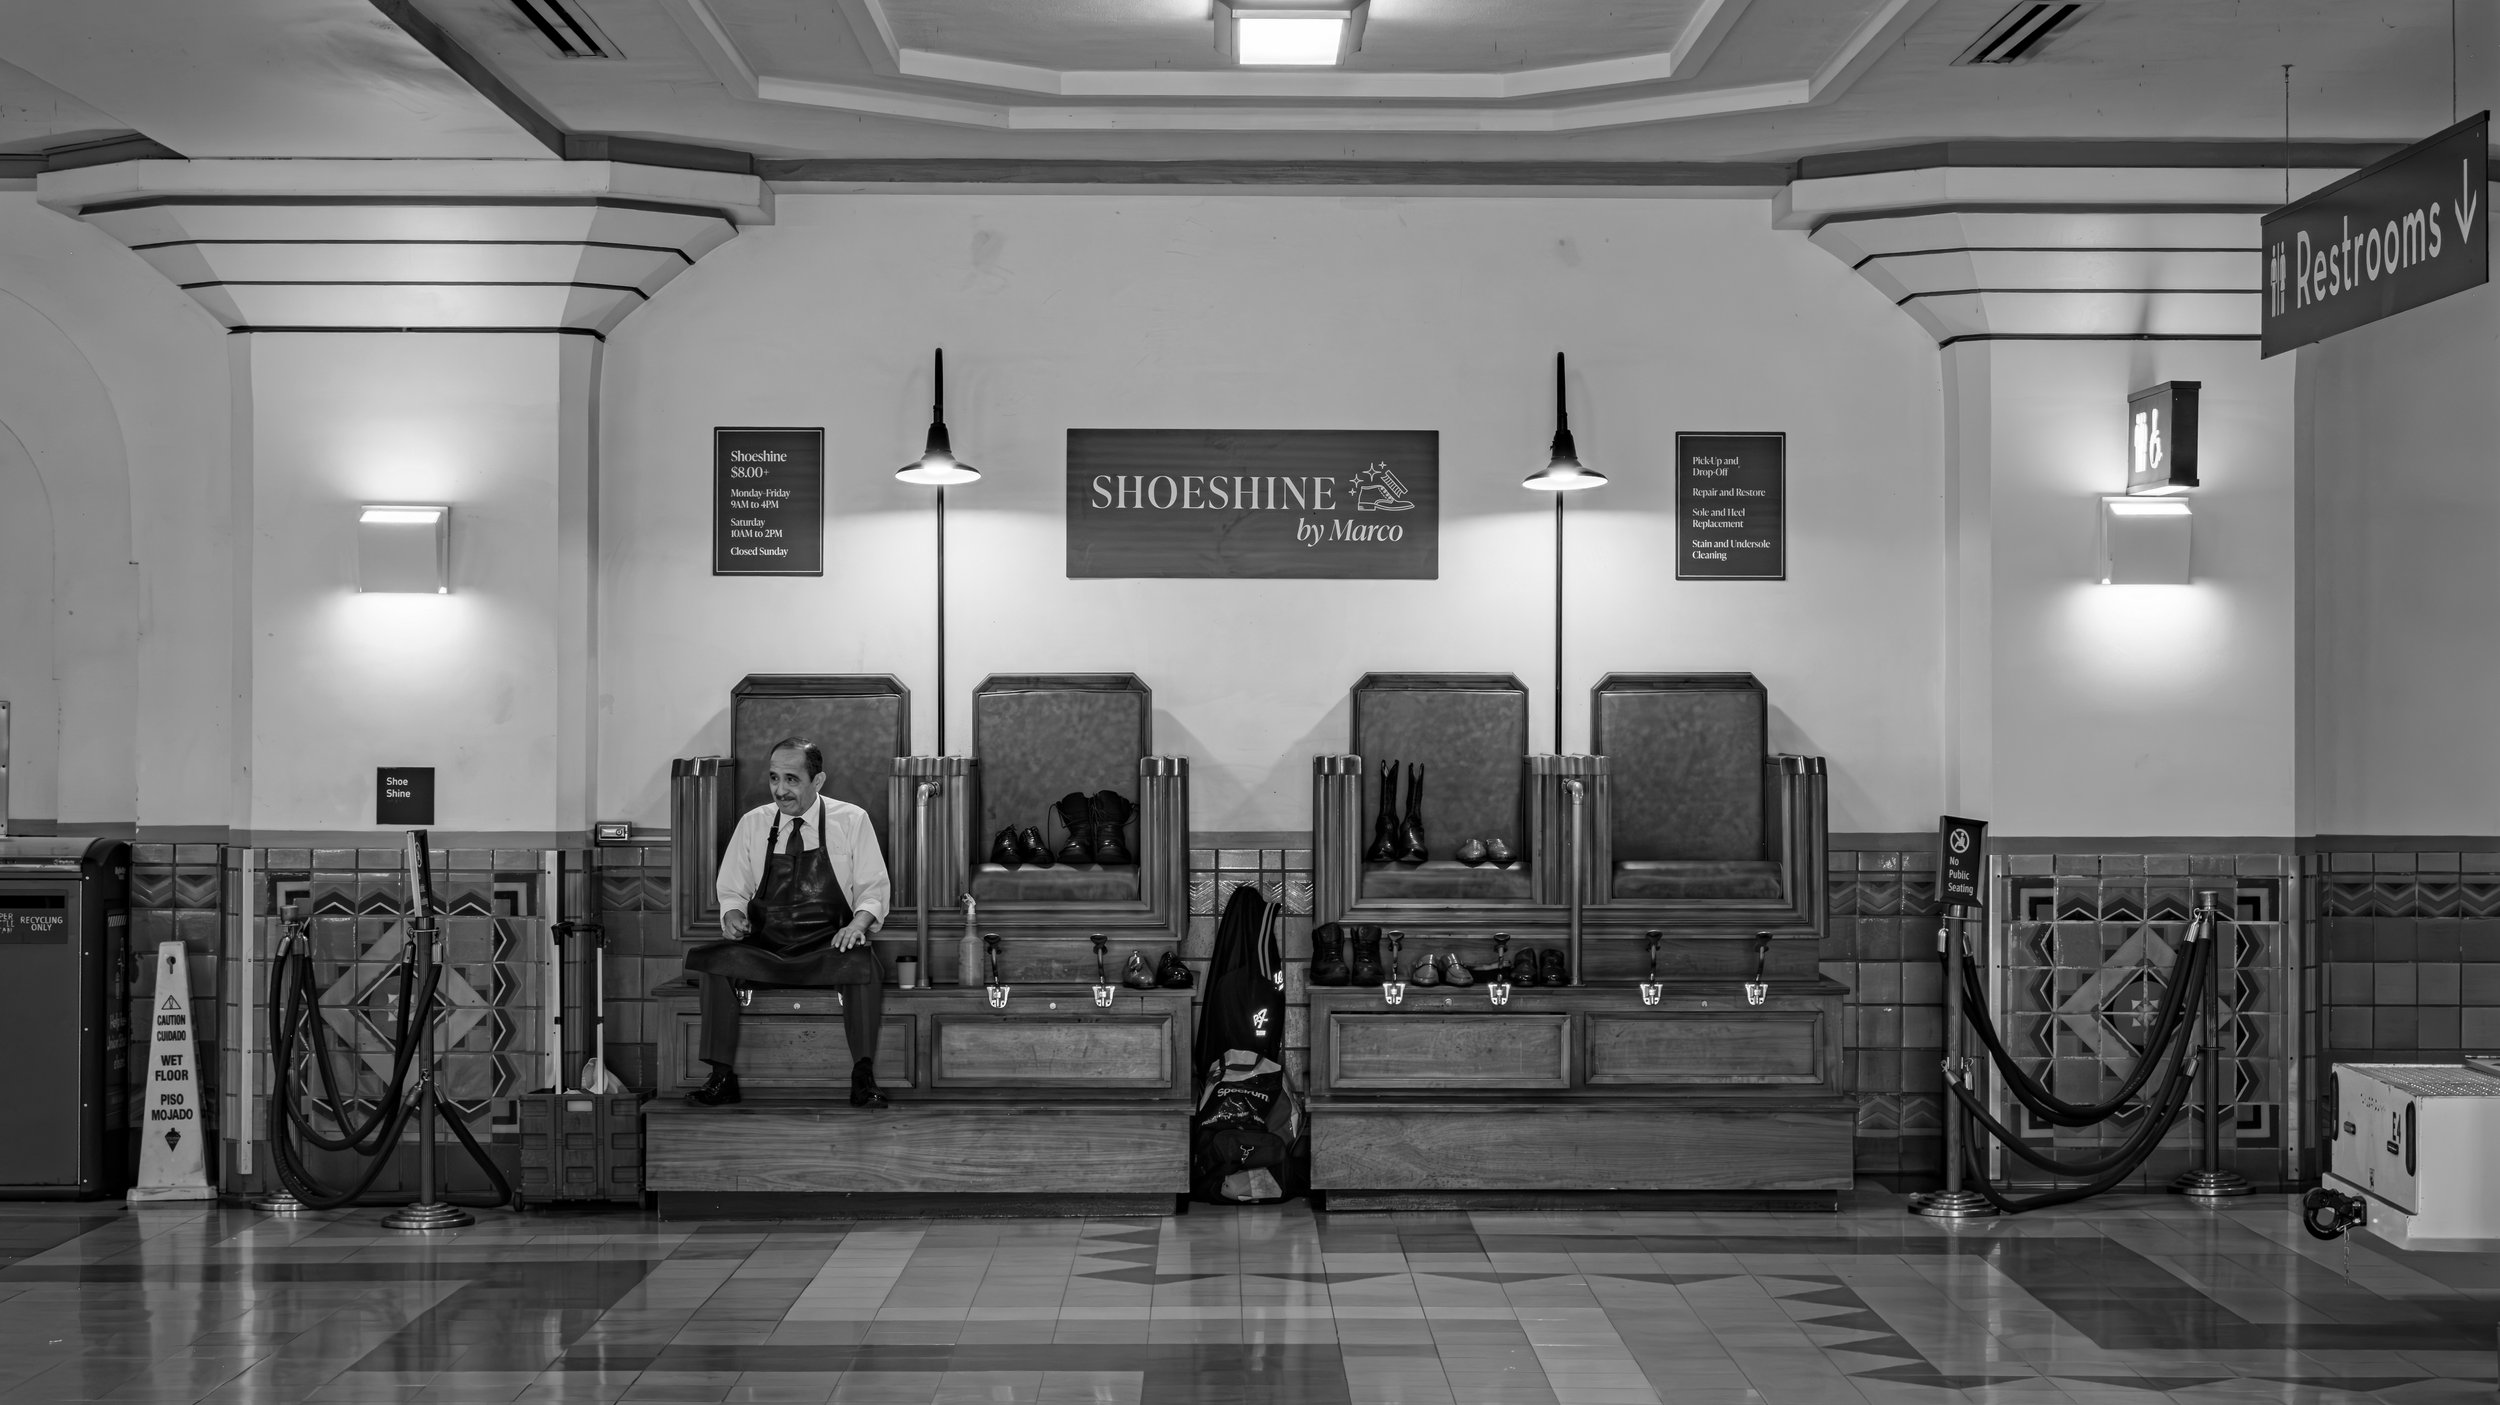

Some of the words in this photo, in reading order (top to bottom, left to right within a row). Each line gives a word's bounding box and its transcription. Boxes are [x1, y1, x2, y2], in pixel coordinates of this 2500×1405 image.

[2296, 201, 2441, 309] Restrooms
[731, 450, 787, 462] Shoeshine
[1693, 456, 1722, 467] Pick-Up
[1724, 457, 1738, 465] and
[731, 467, 770, 478] $8.00+
[1693, 468, 1727, 478] Drop-Off
[1092, 475, 1336, 509] SHOESHINE
[1693, 488, 1718, 498] Repair
[1719, 488, 1734, 496] and
[1736, 488, 1765, 496] Restore
[731, 500, 748, 508] 9AM
[761, 500, 778, 508] 4PM
[1693, 508, 1709, 516] Sole
[1711, 508, 1725, 516] and
[1728, 508, 1745, 516] Heel
[731, 518, 765, 528] Saturday
[1693, 519, 1743, 530] Replacement
[765, 529, 782, 537] 2PM
[1297, 518, 1324, 547] by
[1329, 520, 1403, 541] Marco
[1731, 540, 1770, 548] Undersole
[731, 547, 757, 555] Closed
[759, 547, 788, 557] Sunday
[1692, 551, 1727, 561] Cleaning
[387, 777, 408, 785] Shoe
[387, 789, 410, 797] Shine
[1950, 857, 1959, 865] No
[1949, 869, 1969, 880] Public
[1948, 882, 1973, 896] Seating
[21, 917, 63, 925] RECYCLING
[31, 923, 52, 931] ONLY
[157, 1015, 185, 1025] CAUTION
[157, 1030, 186, 1041] CUIDADO
[161, 1055, 183, 1066] WET
[155, 1070, 188, 1081] FLOOR
[161, 1094, 183, 1105] PISO
[152, 1109, 193, 1120] MOJADO
